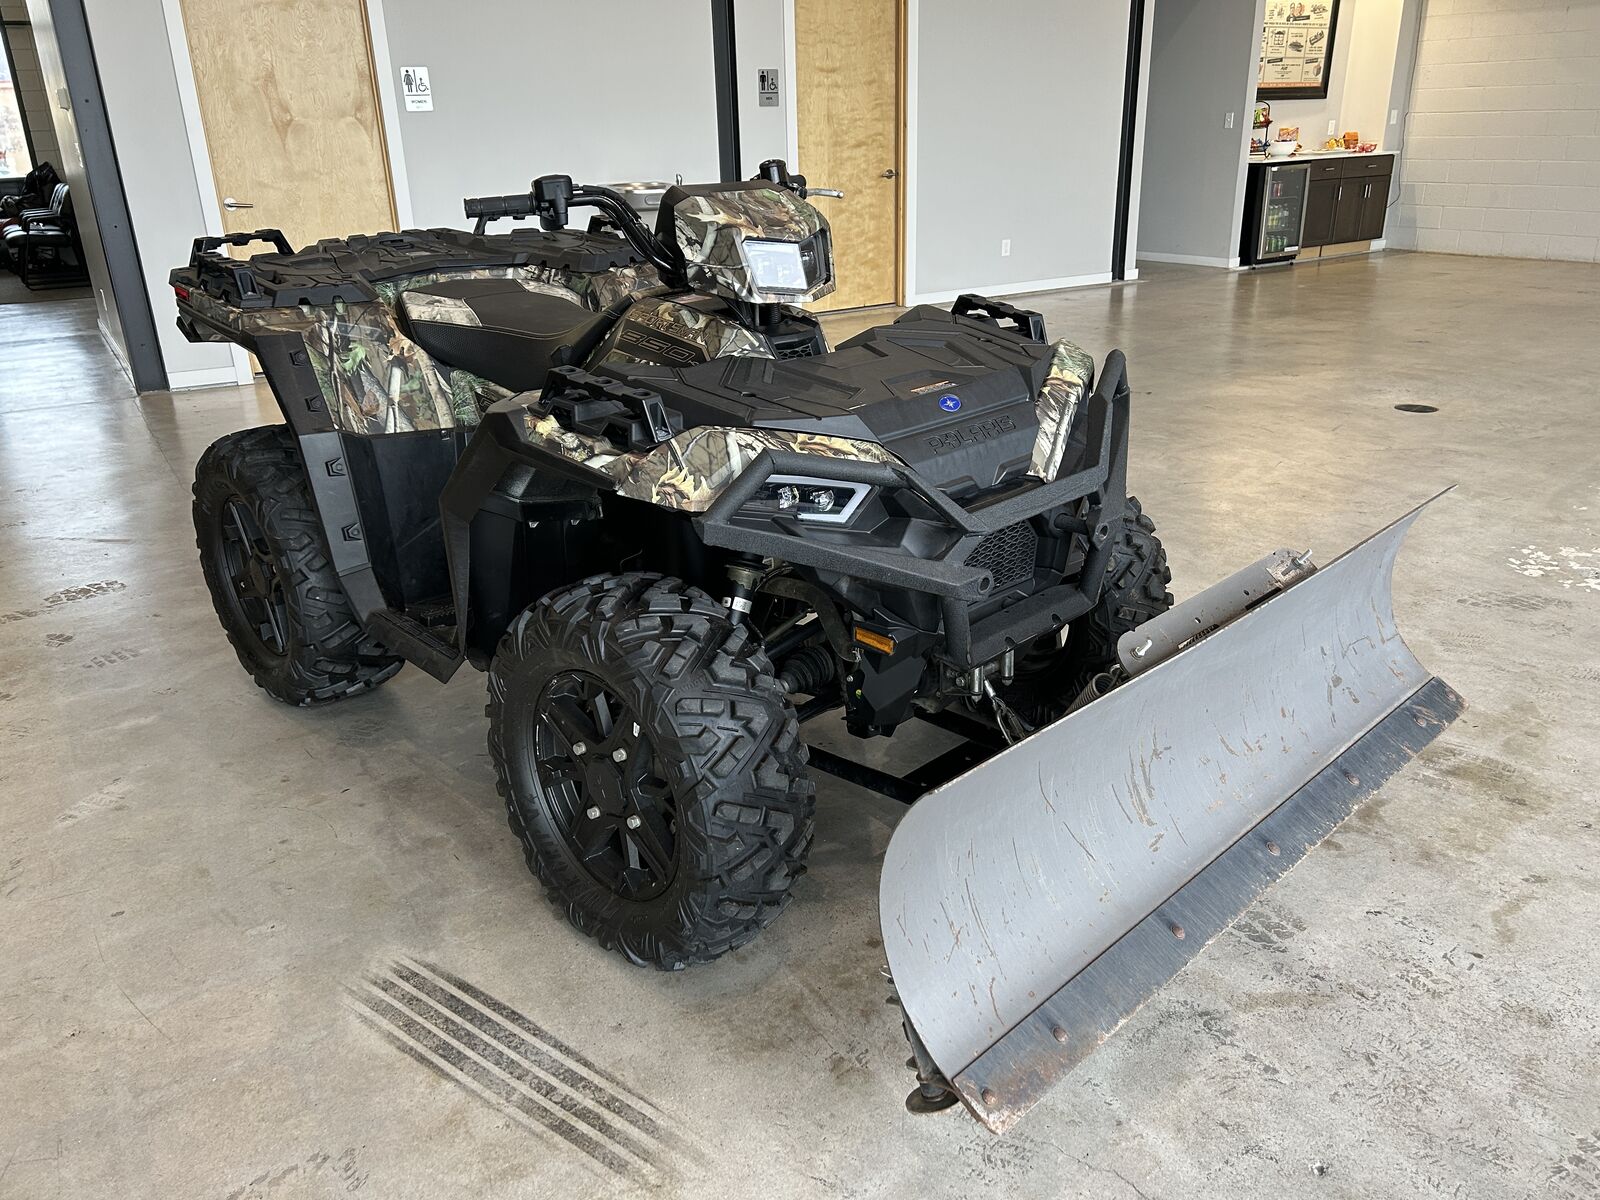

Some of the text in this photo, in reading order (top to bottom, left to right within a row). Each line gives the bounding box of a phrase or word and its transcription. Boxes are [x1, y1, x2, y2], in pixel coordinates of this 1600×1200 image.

[626, 308, 709, 342] SPORTSMAN
[619, 329, 696, 363] 850
[925, 414, 1016, 455] POLARIS
